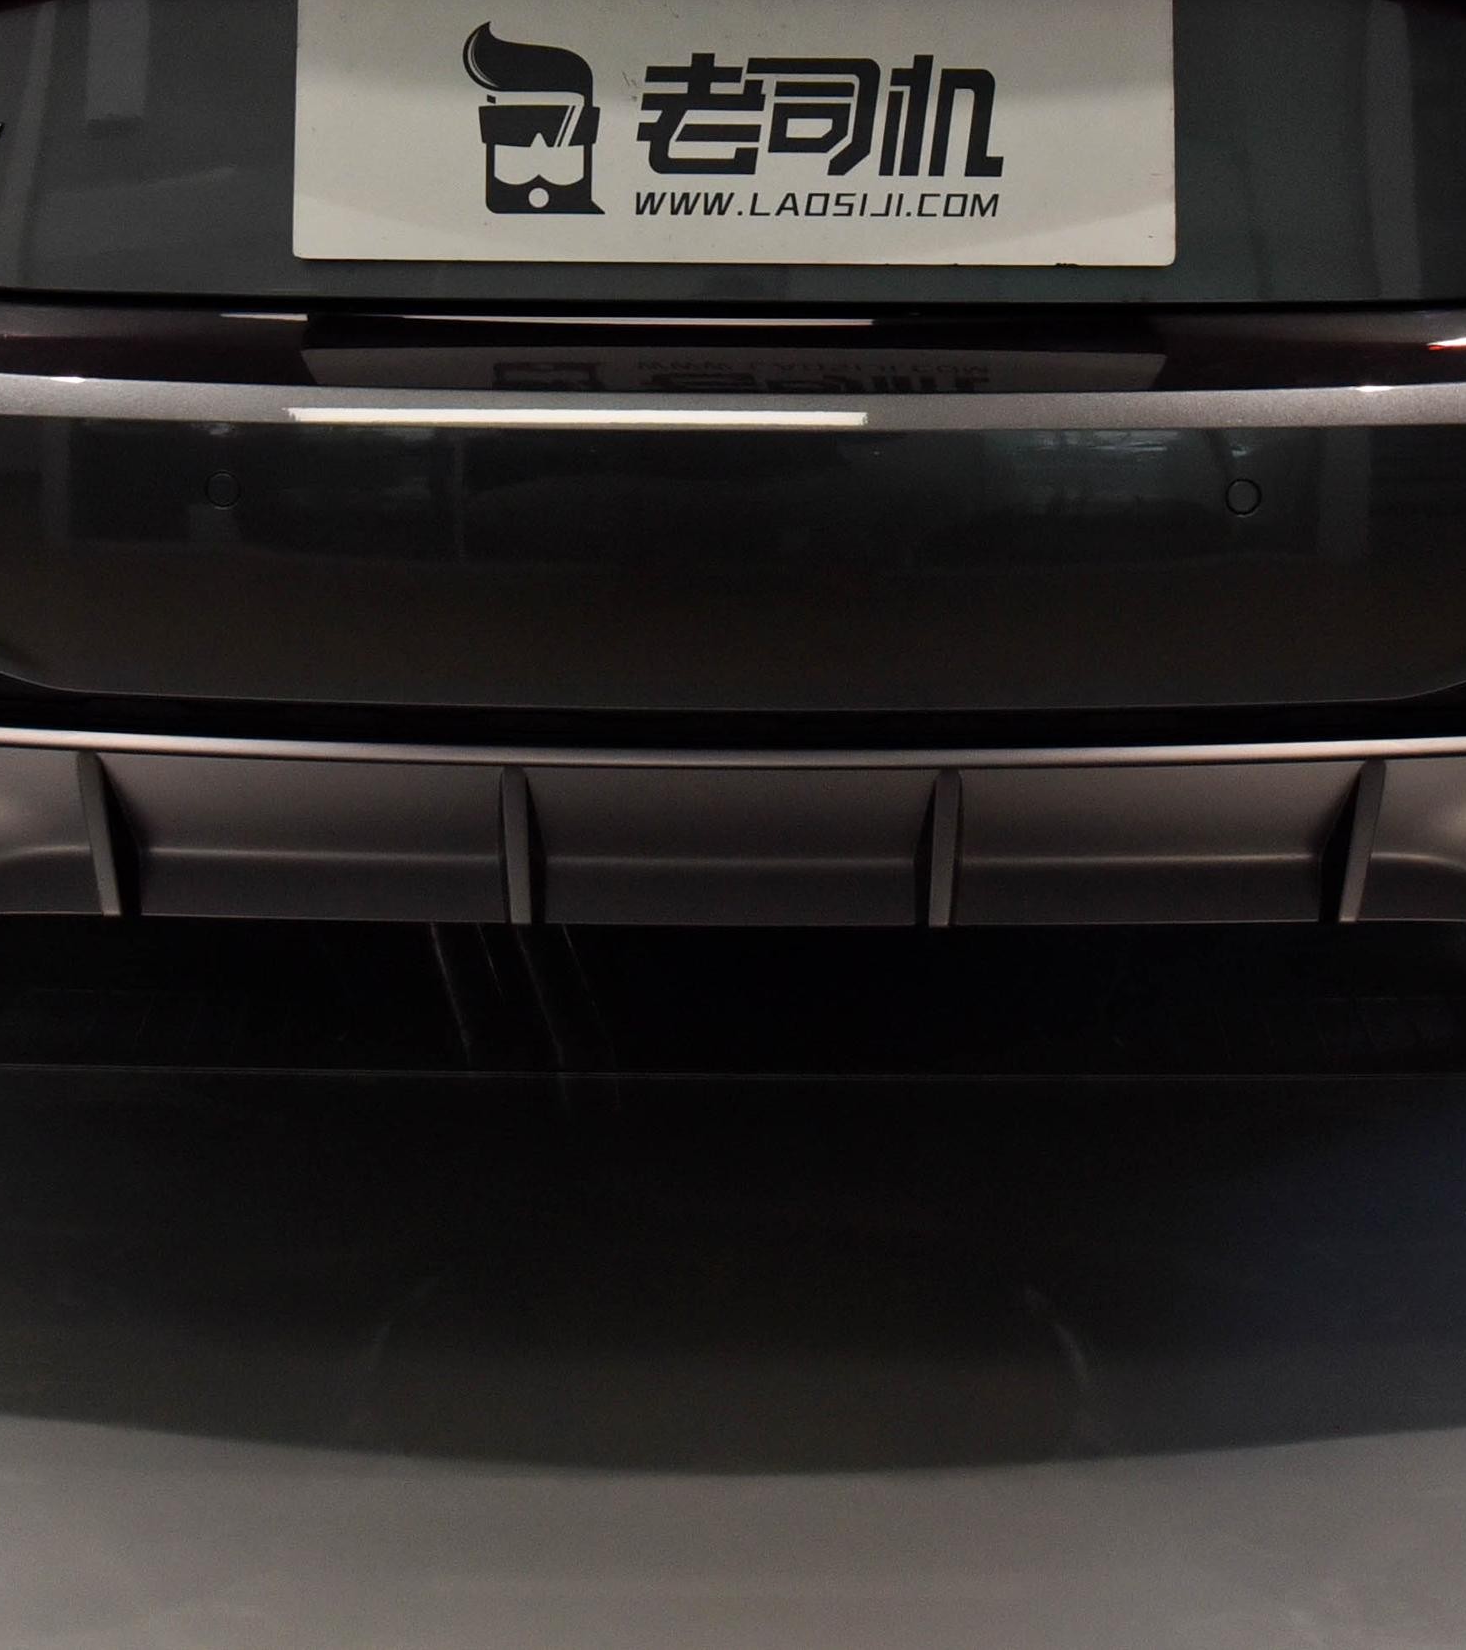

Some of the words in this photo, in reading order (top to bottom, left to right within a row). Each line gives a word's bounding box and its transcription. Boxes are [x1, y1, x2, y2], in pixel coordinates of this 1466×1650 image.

[636, 53, 1004, 176] 老司机
[635, 191, 1000, 218] WWW.LAOSIJI.COM
